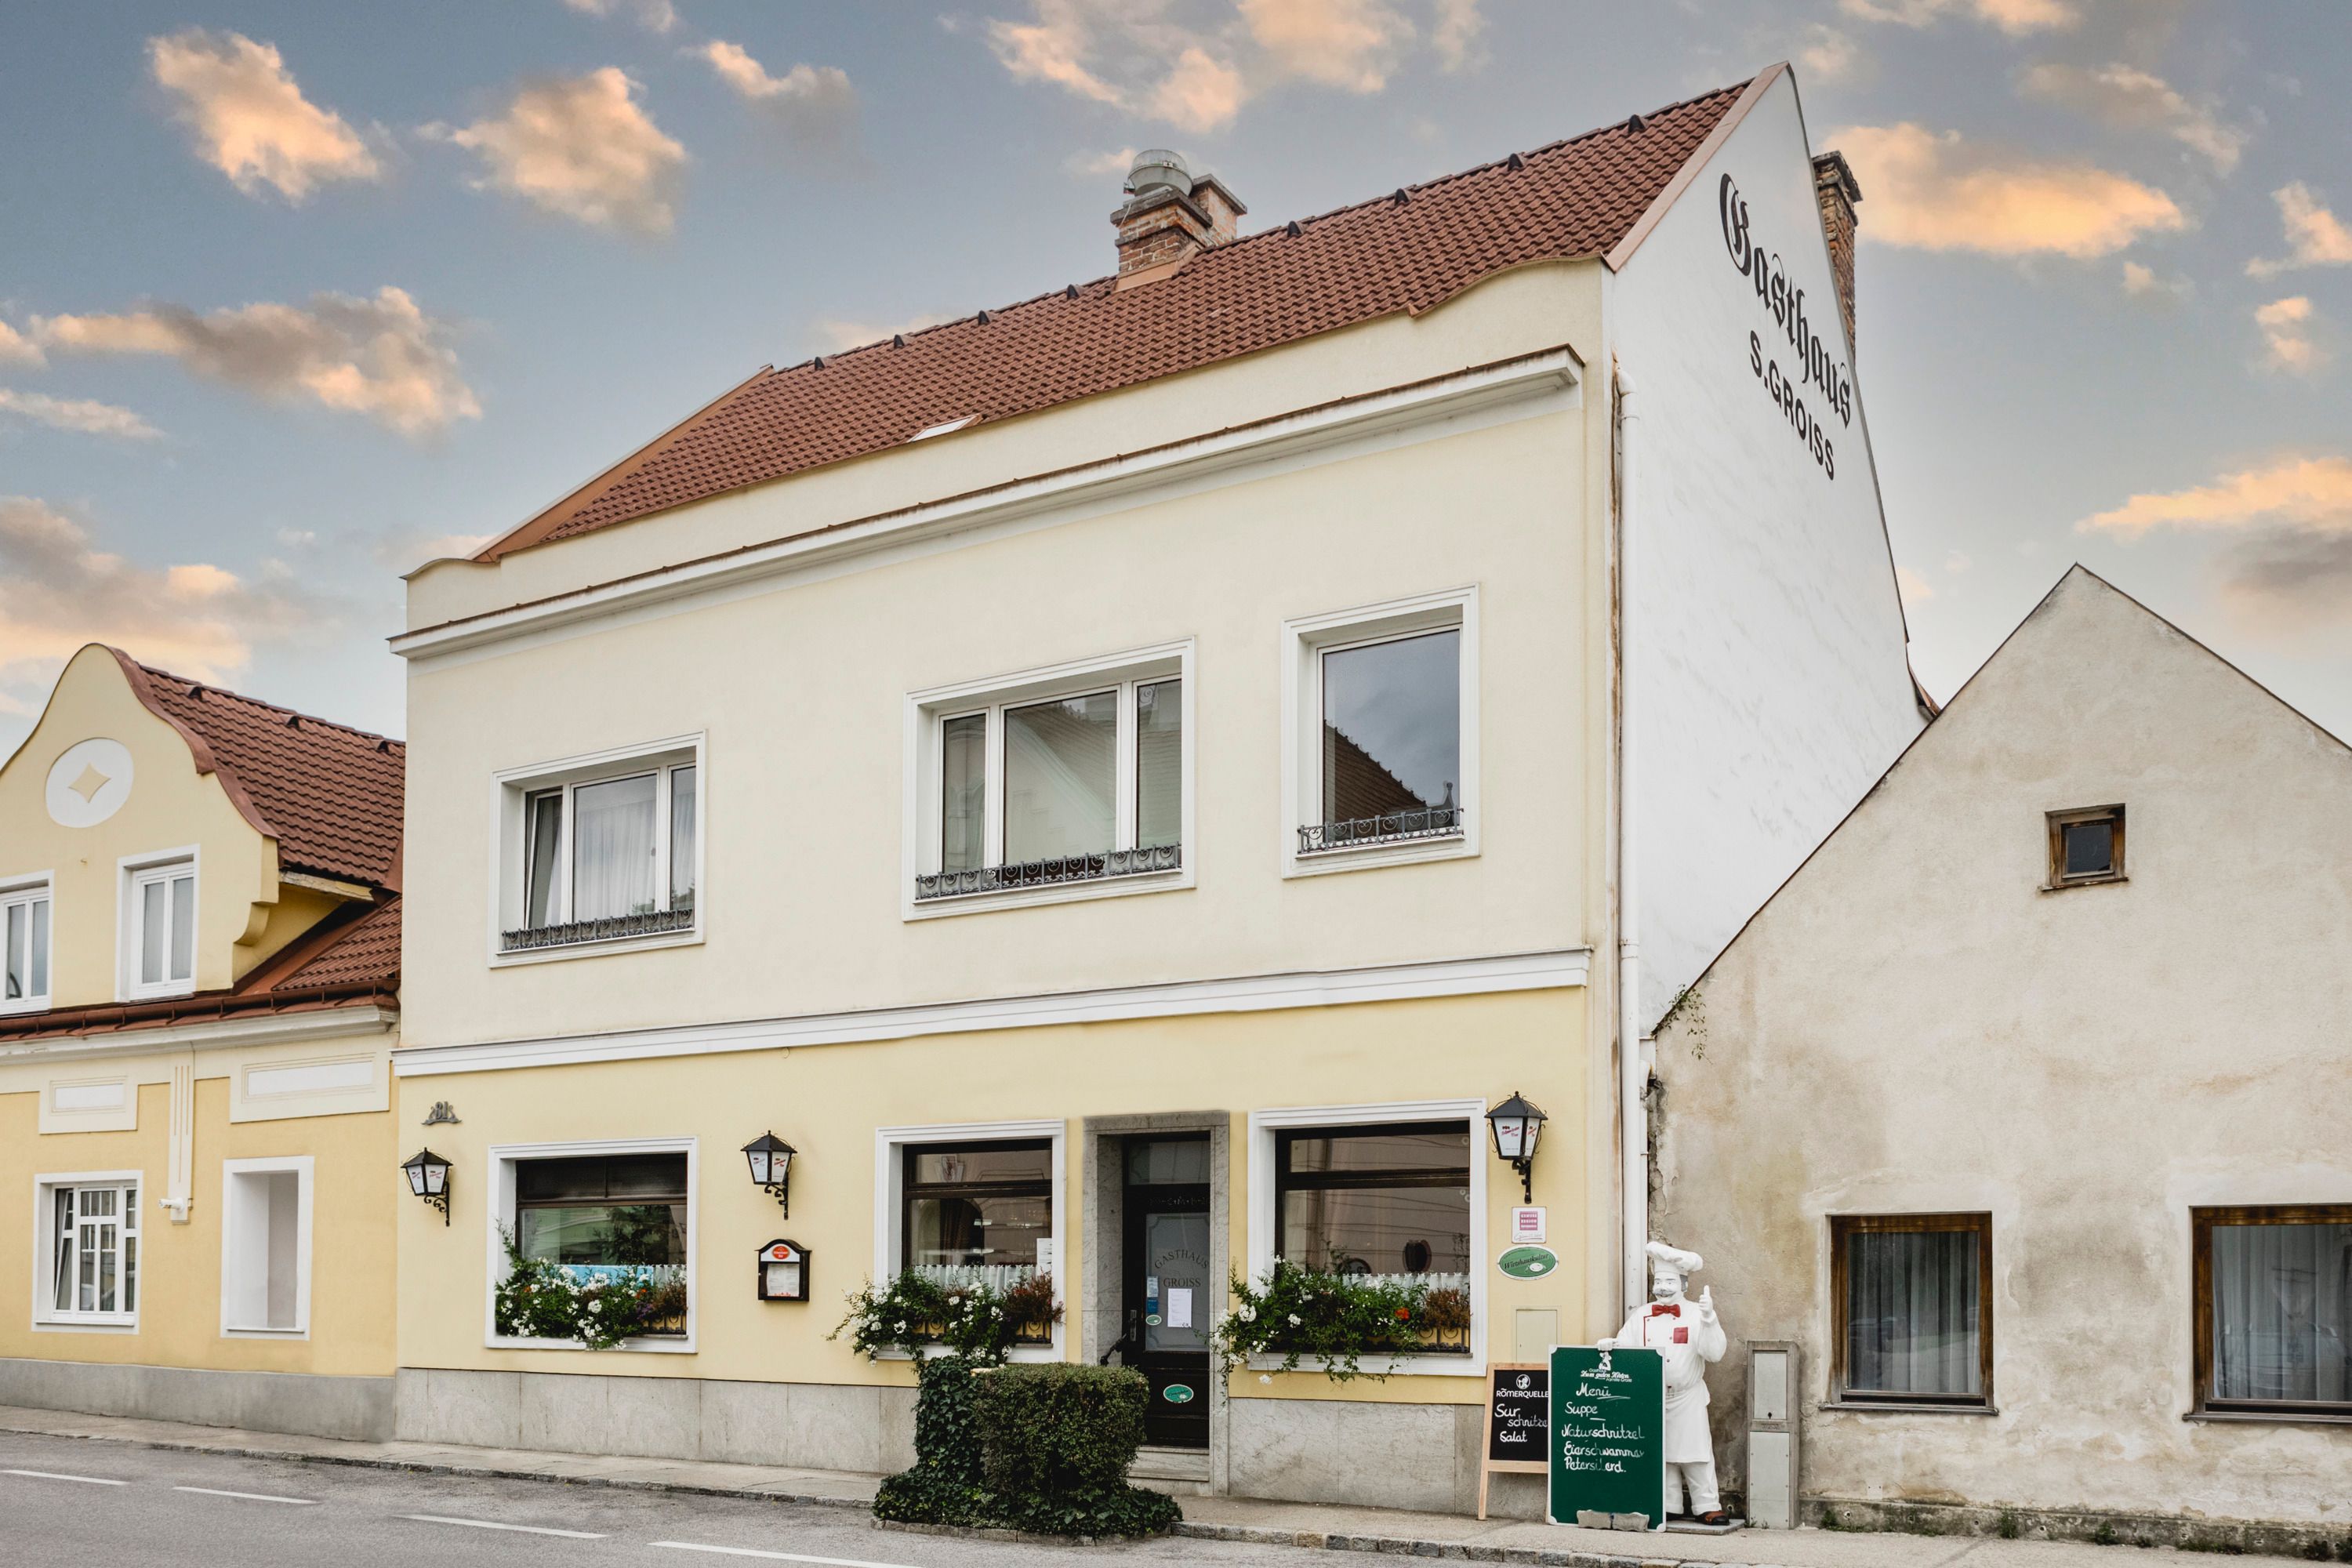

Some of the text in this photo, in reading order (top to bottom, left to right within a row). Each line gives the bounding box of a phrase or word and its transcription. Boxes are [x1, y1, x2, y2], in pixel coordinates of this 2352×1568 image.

[1719, 173, 1850, 429] Gasthaus
[435, 1102, 449, 1120] 81
[1154, 1249, 1210, 1269] GASTHAUS
[1504, 1254, 1550, 1269] Wirtshauskultur
[1163, 1277, 1202, 1287] GROISS
[1576, 1381, 1612, 1397] Menü
[1494, 1403, 1521, 1417] Sur
[1565, 1402, 1599, 1417] Suppe
[1500, 1430, 1527, 1443] Salat
[1562, 1423, 1645, 1439] Naturschnitzel
